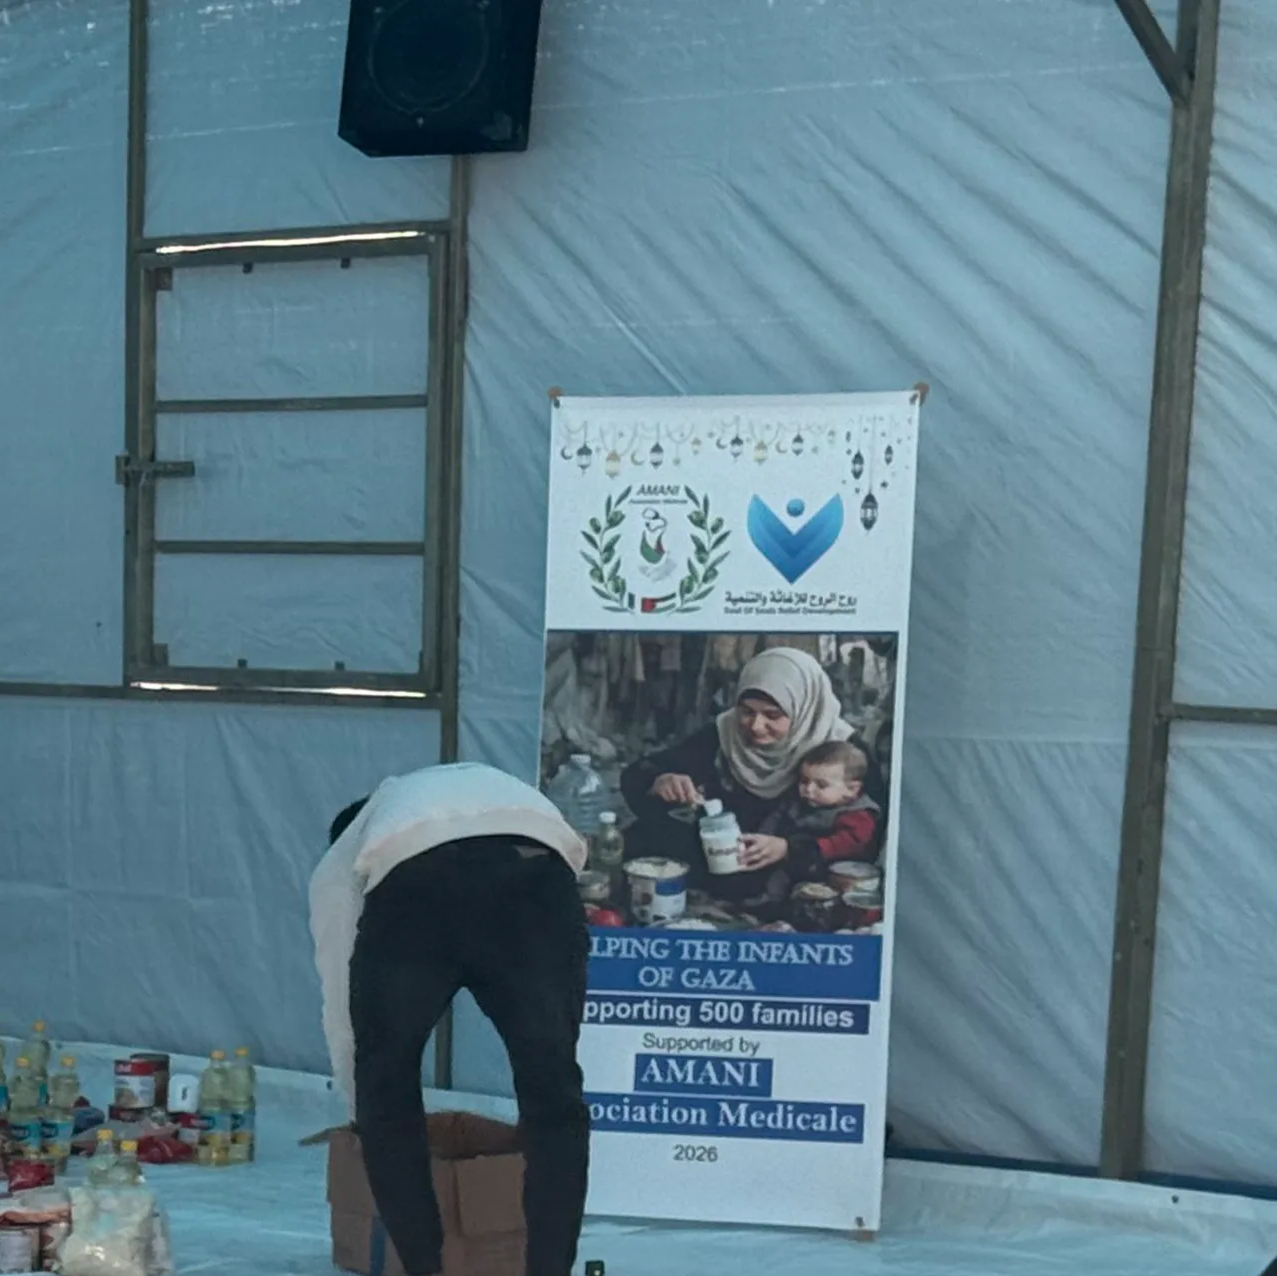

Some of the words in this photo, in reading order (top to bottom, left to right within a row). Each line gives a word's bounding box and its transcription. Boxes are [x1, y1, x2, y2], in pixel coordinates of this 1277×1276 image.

[589, 936, 670, 959] LPING
[675, 938, 731, 962] THE
[738, 939, 854, 966] INFANTS
[638, 966, 674, 987] OF
[681, 966, 756, 991] GAZA
[583, 998, 691, 1026] pporting
[699, 1001, 745, 1023] 500
[752, 1002, 855, 1029] families
[643, 1032, 734, 1054] Supported
[739, 1036, 761, 1056] by
[641, 1058, 761, 1088] AMANI
[590, 1098, 708, 1126] ociation
[717, 1101, 857, 1134] Medicale
[673, 1144, 719, 1161] 2026
